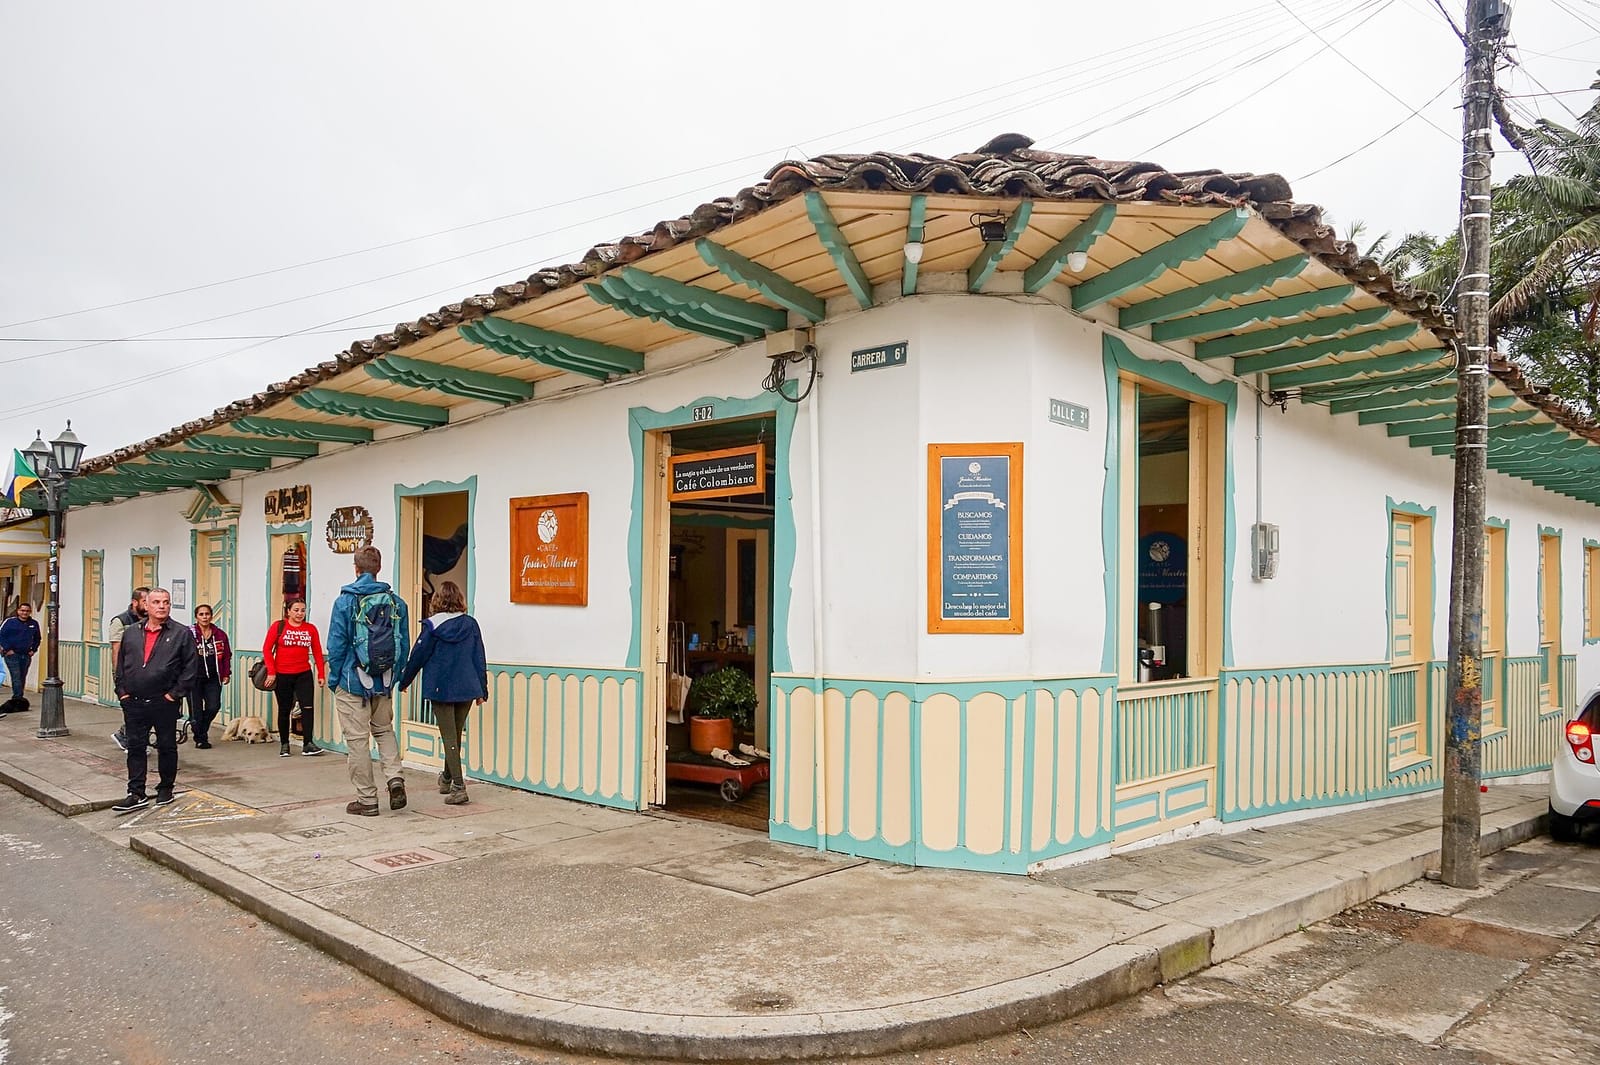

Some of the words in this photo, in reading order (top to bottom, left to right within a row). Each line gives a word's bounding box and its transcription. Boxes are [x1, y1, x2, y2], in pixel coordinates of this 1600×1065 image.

[852, 351, 886, 368] CARRERA
[694, 406, 713, 420] 3-02
[1052, 403, 1075, 421] CALLE
[675, 470, 682, 478] La
[717, 465, 723, 473] de
[730, 461, 755, 471] verdadero
[676, 479, 698, 491] Café
[699, 474, 755, 488] Colombiano
[957, 511, 993, 519] BUSCAMOS
[996, 602, 1007, 610] del
